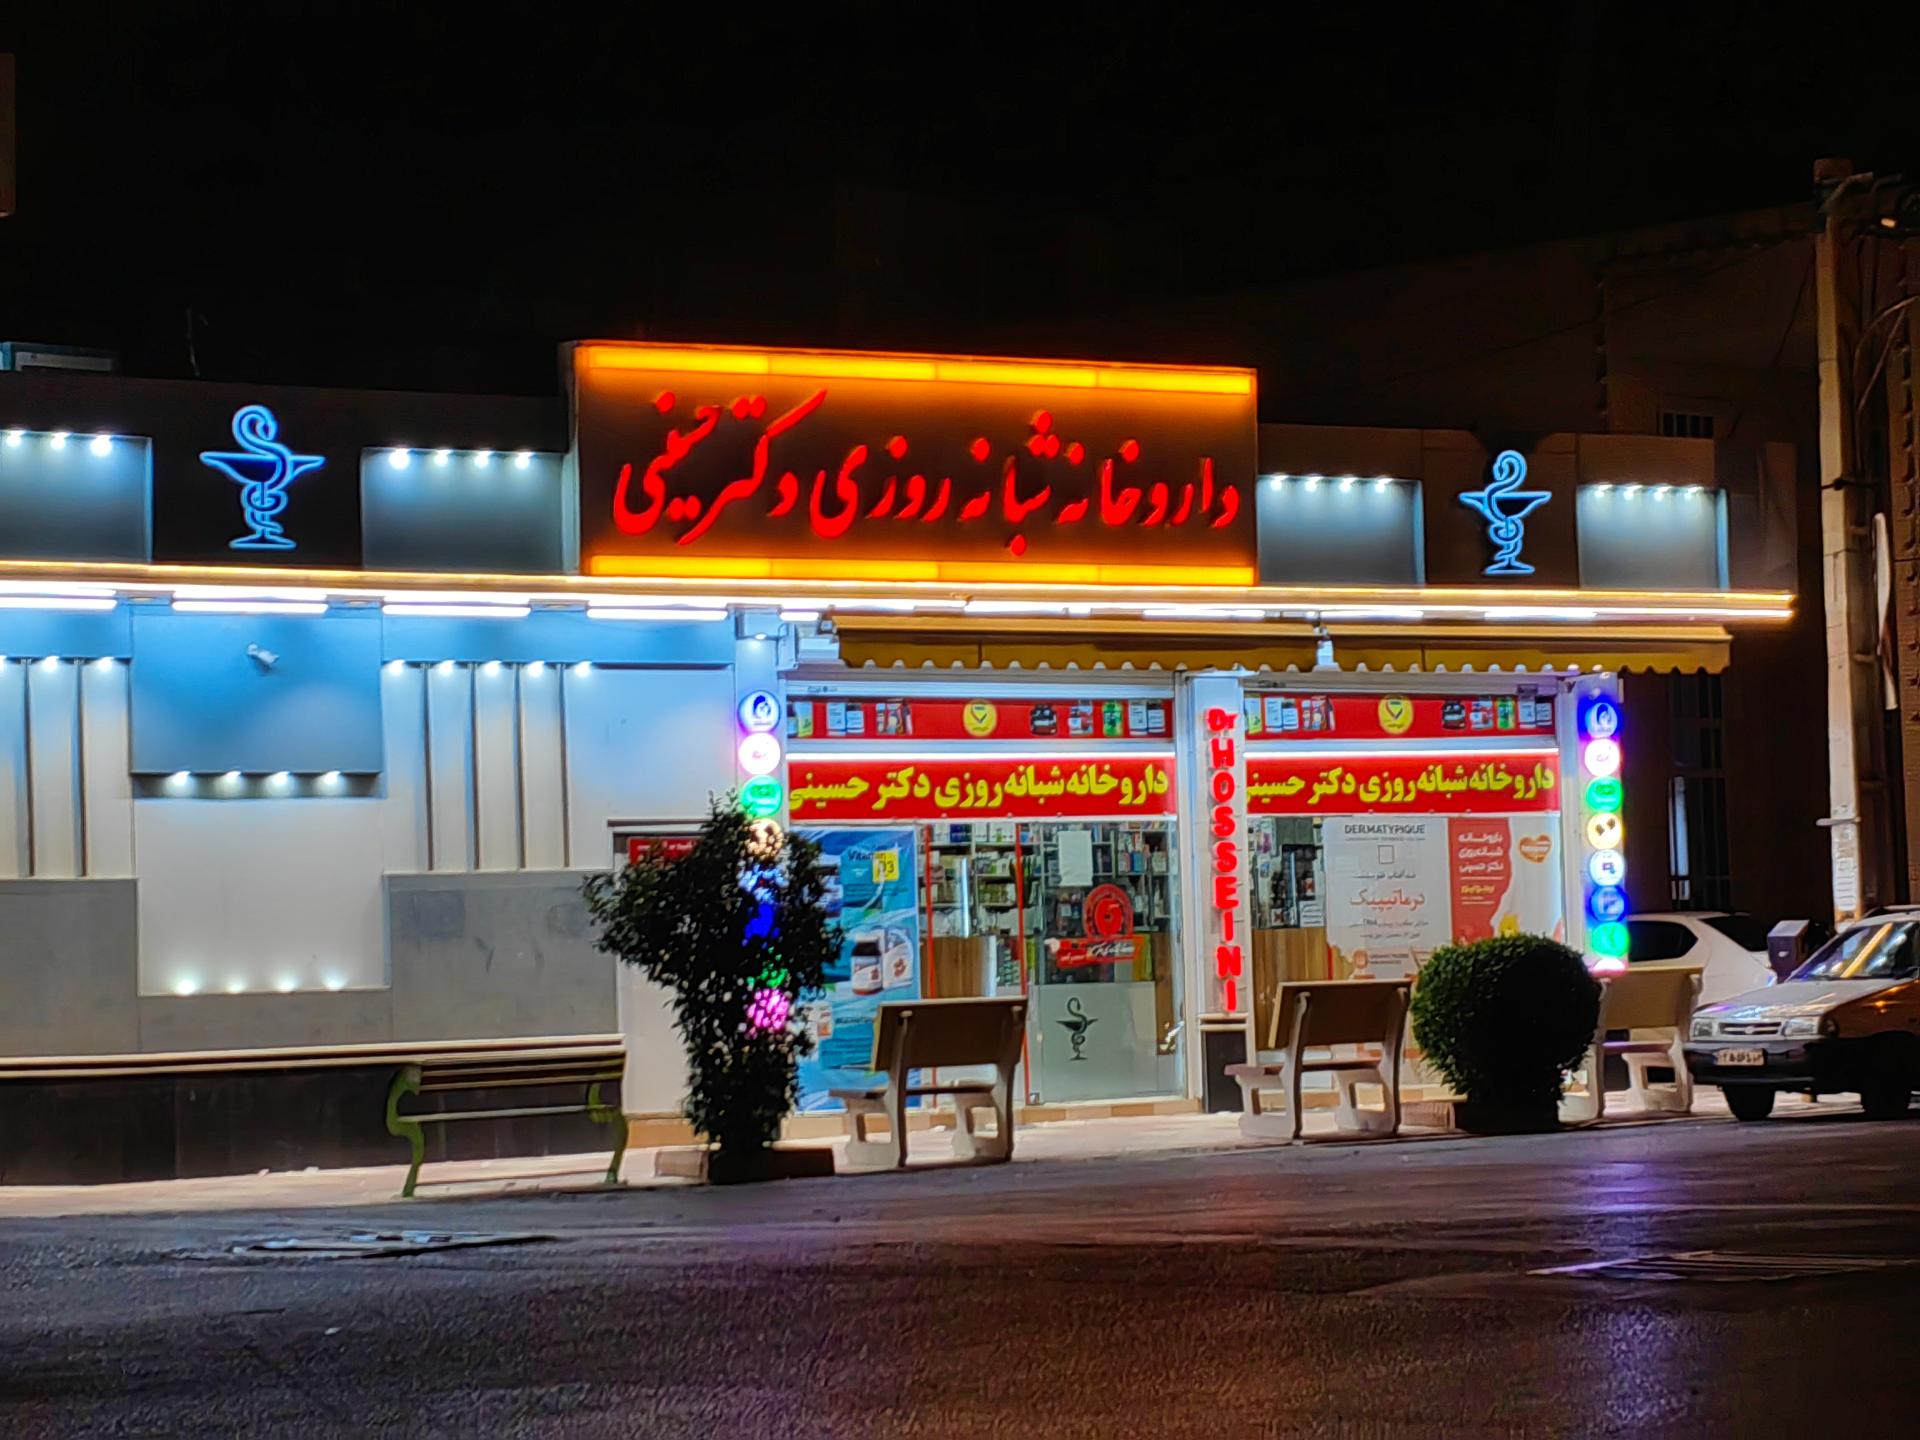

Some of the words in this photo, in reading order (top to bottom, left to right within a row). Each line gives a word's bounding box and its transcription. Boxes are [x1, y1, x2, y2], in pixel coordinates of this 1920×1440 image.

[613, 389, 719, 536] حسینی
[676, 389, 829, 553] دکتر
[961, 405, 1060, 559] شبانه
[1057, 439, 1240, 528] داروخانه
[811, 436, 951, 539] روزی
[1205, 708, 1238, 734] Dr
[788, 772, 870, 812] حسینی
[871, 765, 931, 811] دکتر
[934, 771, 1004, 809] روزی
[1004, 764, 1066, 808] شبانه
[1065, 763, 1171, 807] داروخانه
[1307, 766, 1358, 805] دکتر
[1358, 774, 1417, 804] روزی
[1416, 763, 1470, 802] شبانه
[1469, 762, 1557, 800] داروخانه
